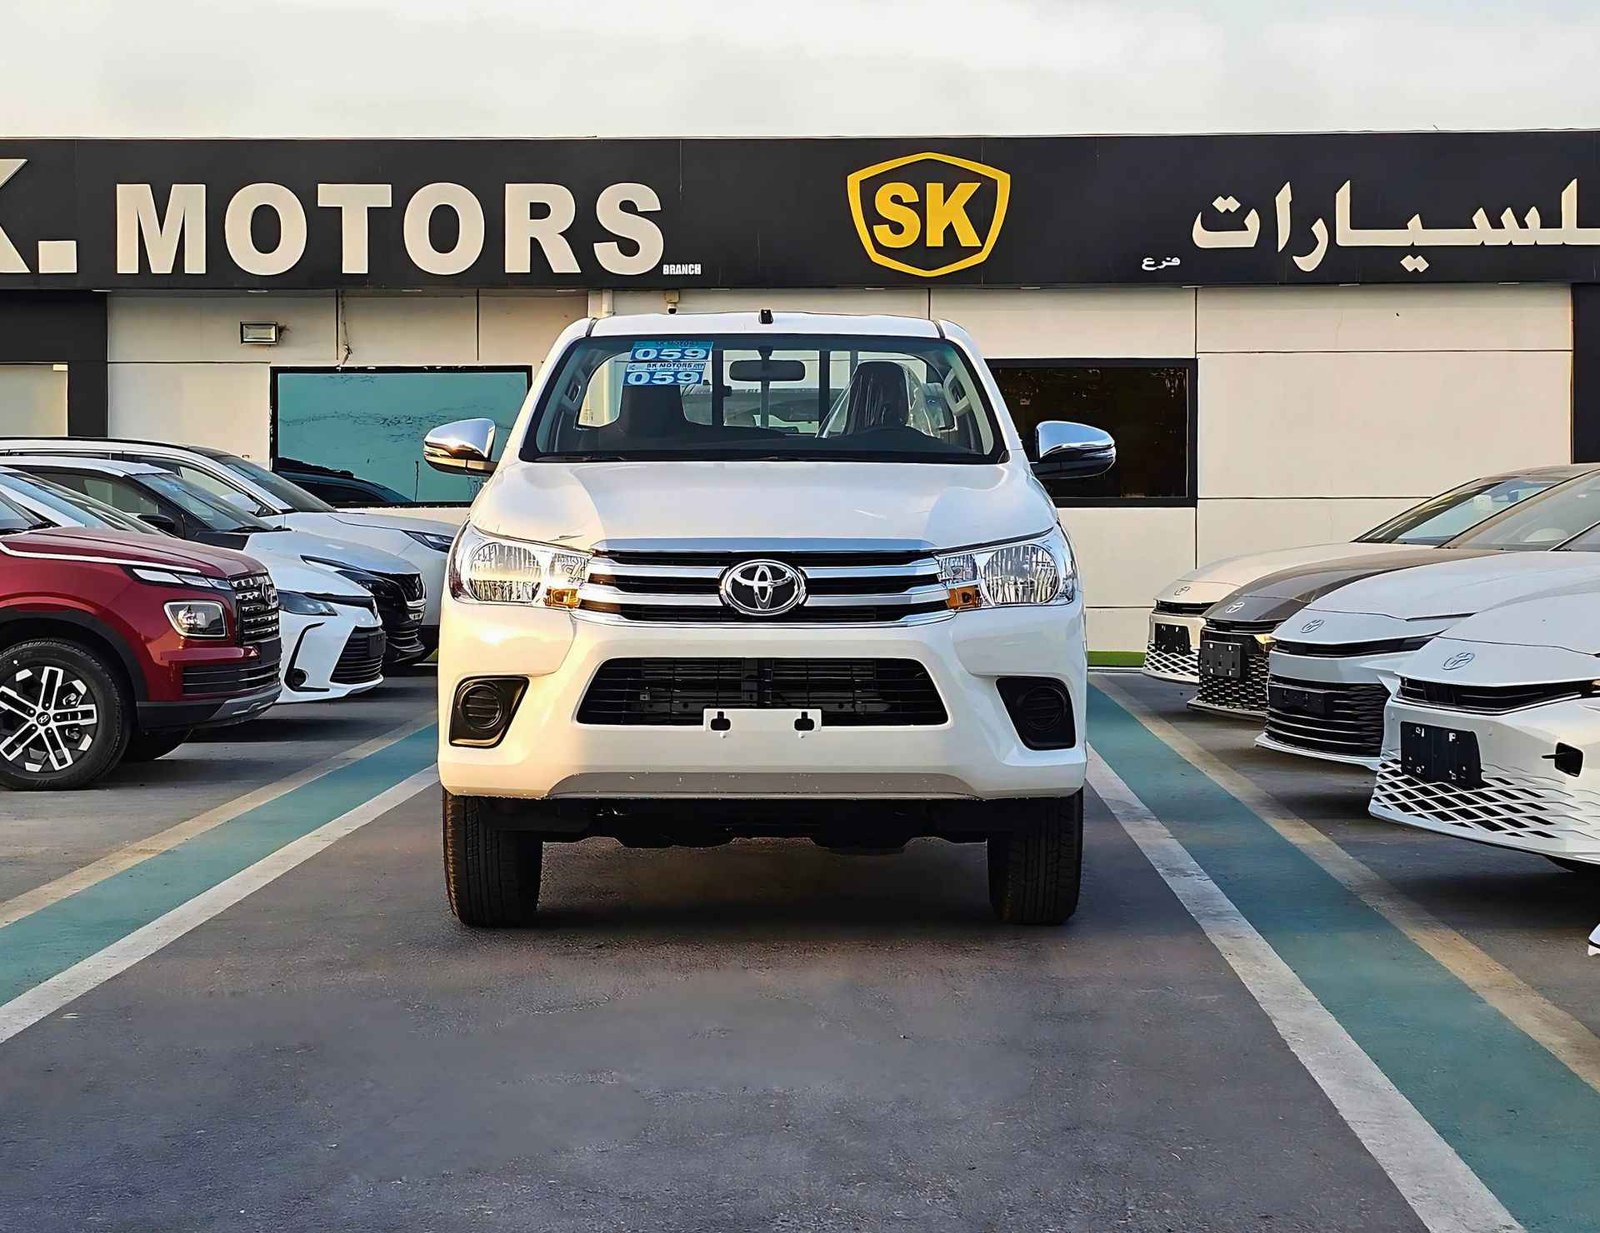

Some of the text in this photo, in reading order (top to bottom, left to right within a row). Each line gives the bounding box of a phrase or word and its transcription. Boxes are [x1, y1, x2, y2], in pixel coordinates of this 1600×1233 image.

[116, 182, 664, 276] MOTORS
[874, 182, 982, 248] SK
[1192, 178, 1600, 273] لسيارات
[662, 263, 702, 275] BRANCH
[634, 348, 707, 360] 059
[627, 371, 700, 385] 059
